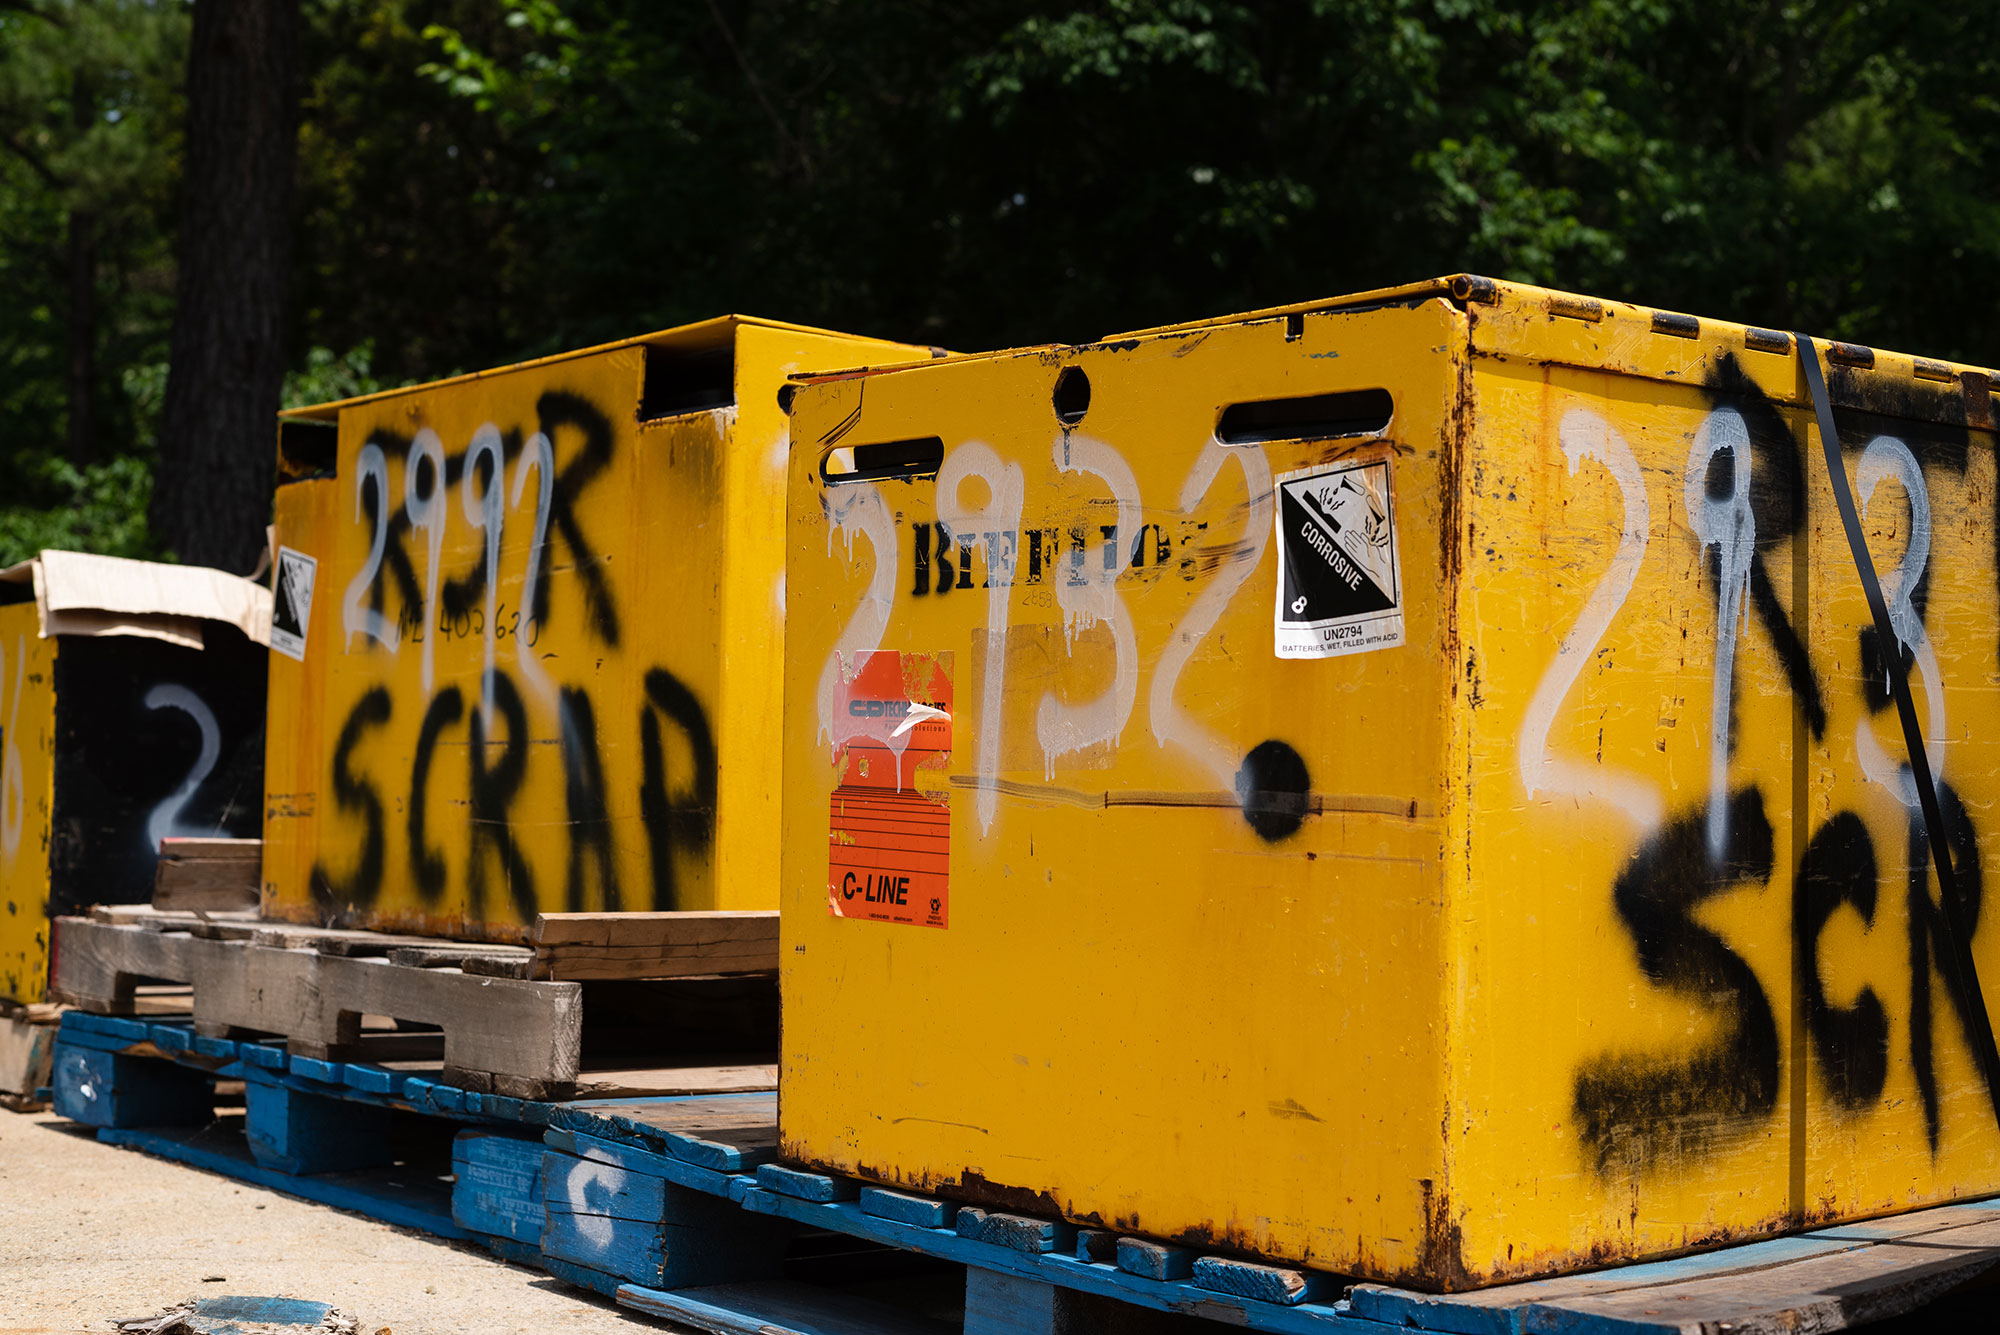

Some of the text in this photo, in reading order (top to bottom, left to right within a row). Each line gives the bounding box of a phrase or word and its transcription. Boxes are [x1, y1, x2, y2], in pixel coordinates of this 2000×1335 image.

[1301, 521, 1363, 591] CORROSIVE
[817, 432, 1272, 838] 2932
[1291, 595, 1308, 614] 8
[1323, 625, 1363, 641] UN2794
[1517, 405, 1947, 868] 293
[1343, 638, 1365, 648] FILLED
[1366, 636, 1382, 645] WITH
[1382, 632, 1399, 642] ACID
[145, 683, 236, 860] 2
[310, 664, 720, 926] SCRAP
[843, 871, 911, 907] C-LINE
